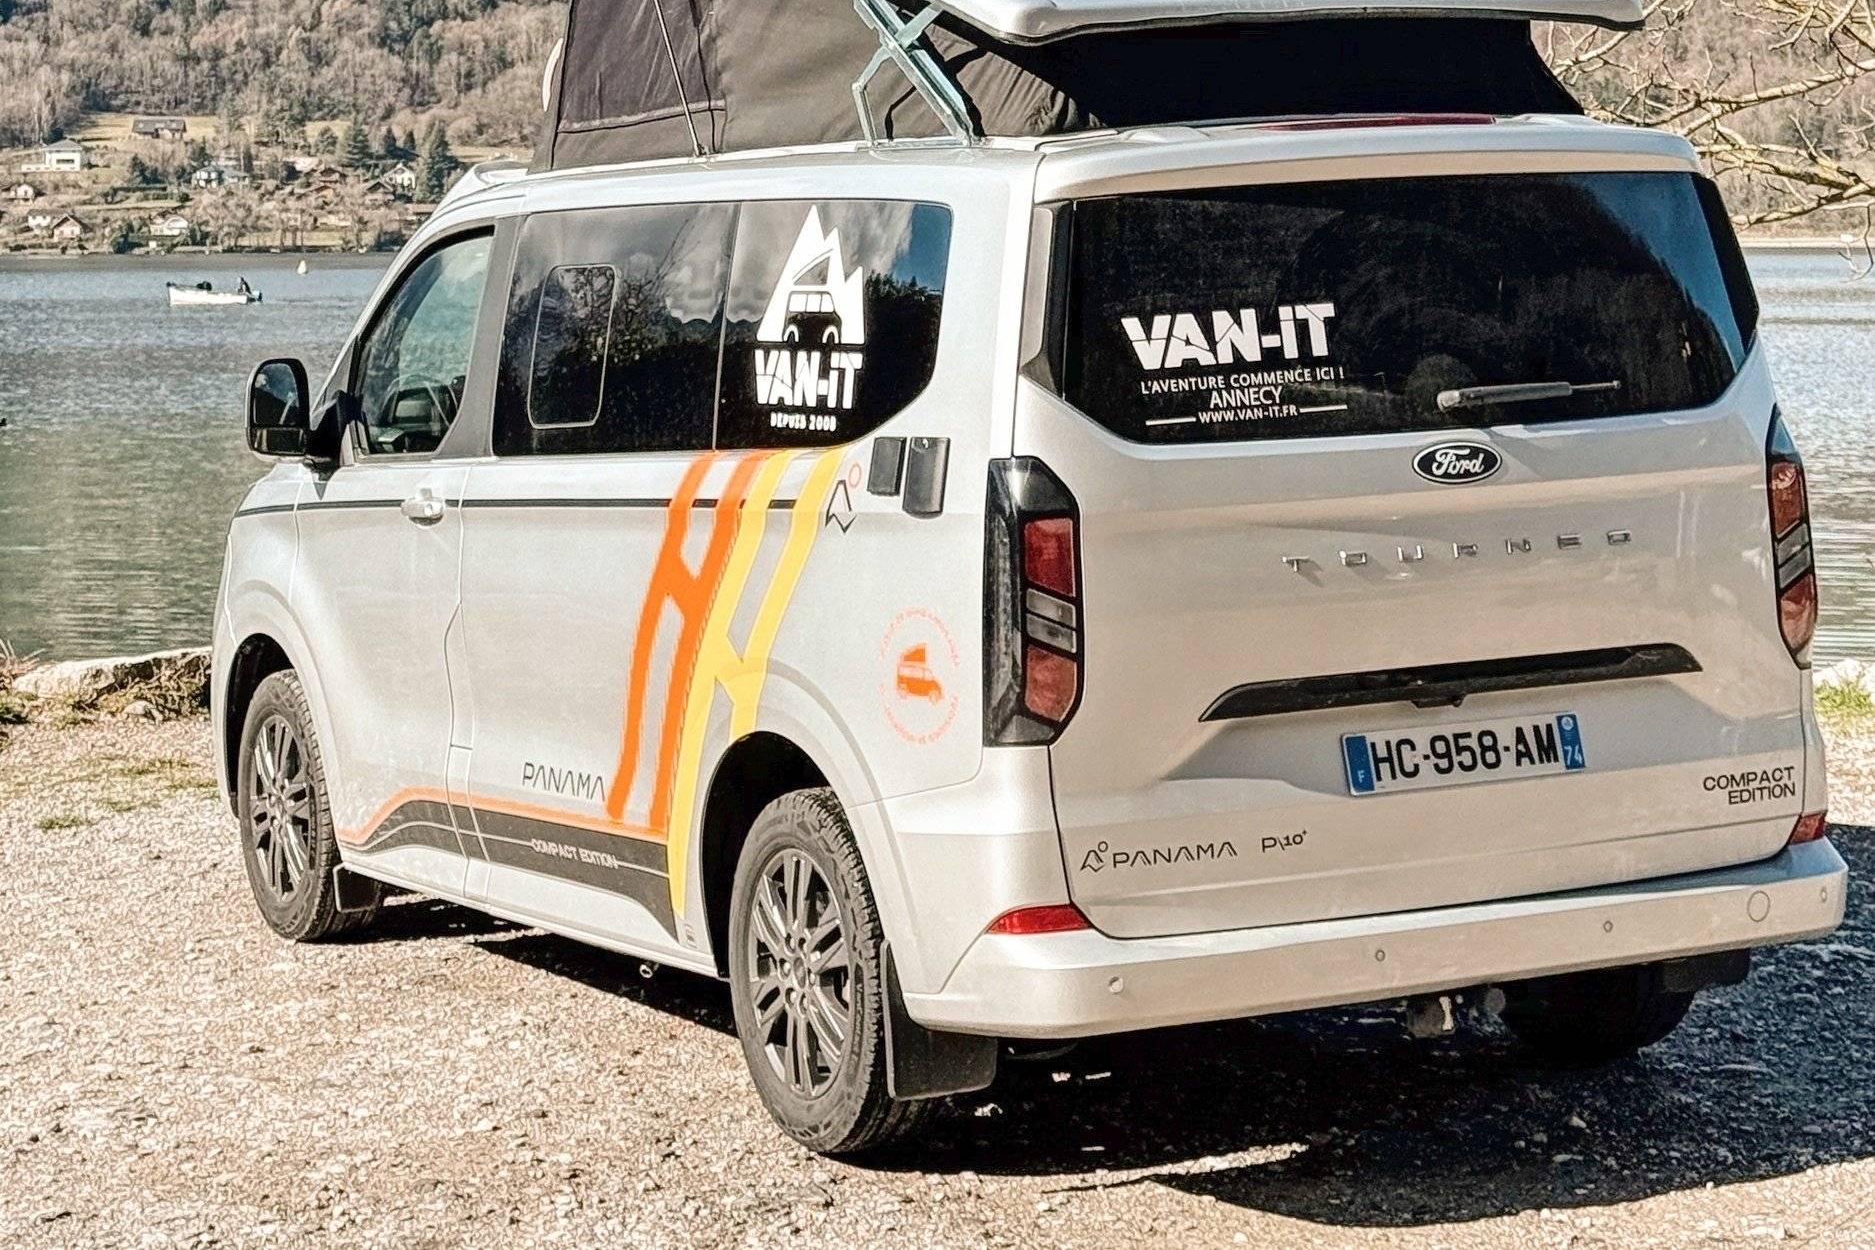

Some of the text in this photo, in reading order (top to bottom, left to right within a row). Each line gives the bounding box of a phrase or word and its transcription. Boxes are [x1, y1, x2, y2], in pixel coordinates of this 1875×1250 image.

[1141, 375, 1226, 395] L'AVENTURE
[1230, 368, 1312, 388] COMMENCE
[1316, 366, 1335, 381] ICI
[1209, 385, 1284, 409] ANNECY
[770, 411, 807, 430] DEPUIS
[1198, 405, 1299, 424] WWW.VAN-IT.FR
[1431, 448, 1485, 477] Ford
[1282, 529, 1633, 573] TOURNEO
[1370, 723, 1560, 782] HC-958-AM
[1563, 744, 1583, 766] 74
[522, 762, 606, 802] PANAMA
[1357, 770, 1365, 784] F
[1702, 766, 1795, 791] COMPACT
[1727, 781, 1796, 805] EDITION
[530, 838, 619, 870] COMPACT EDITION
[1112, 841, 1238, 869] PANAMA
